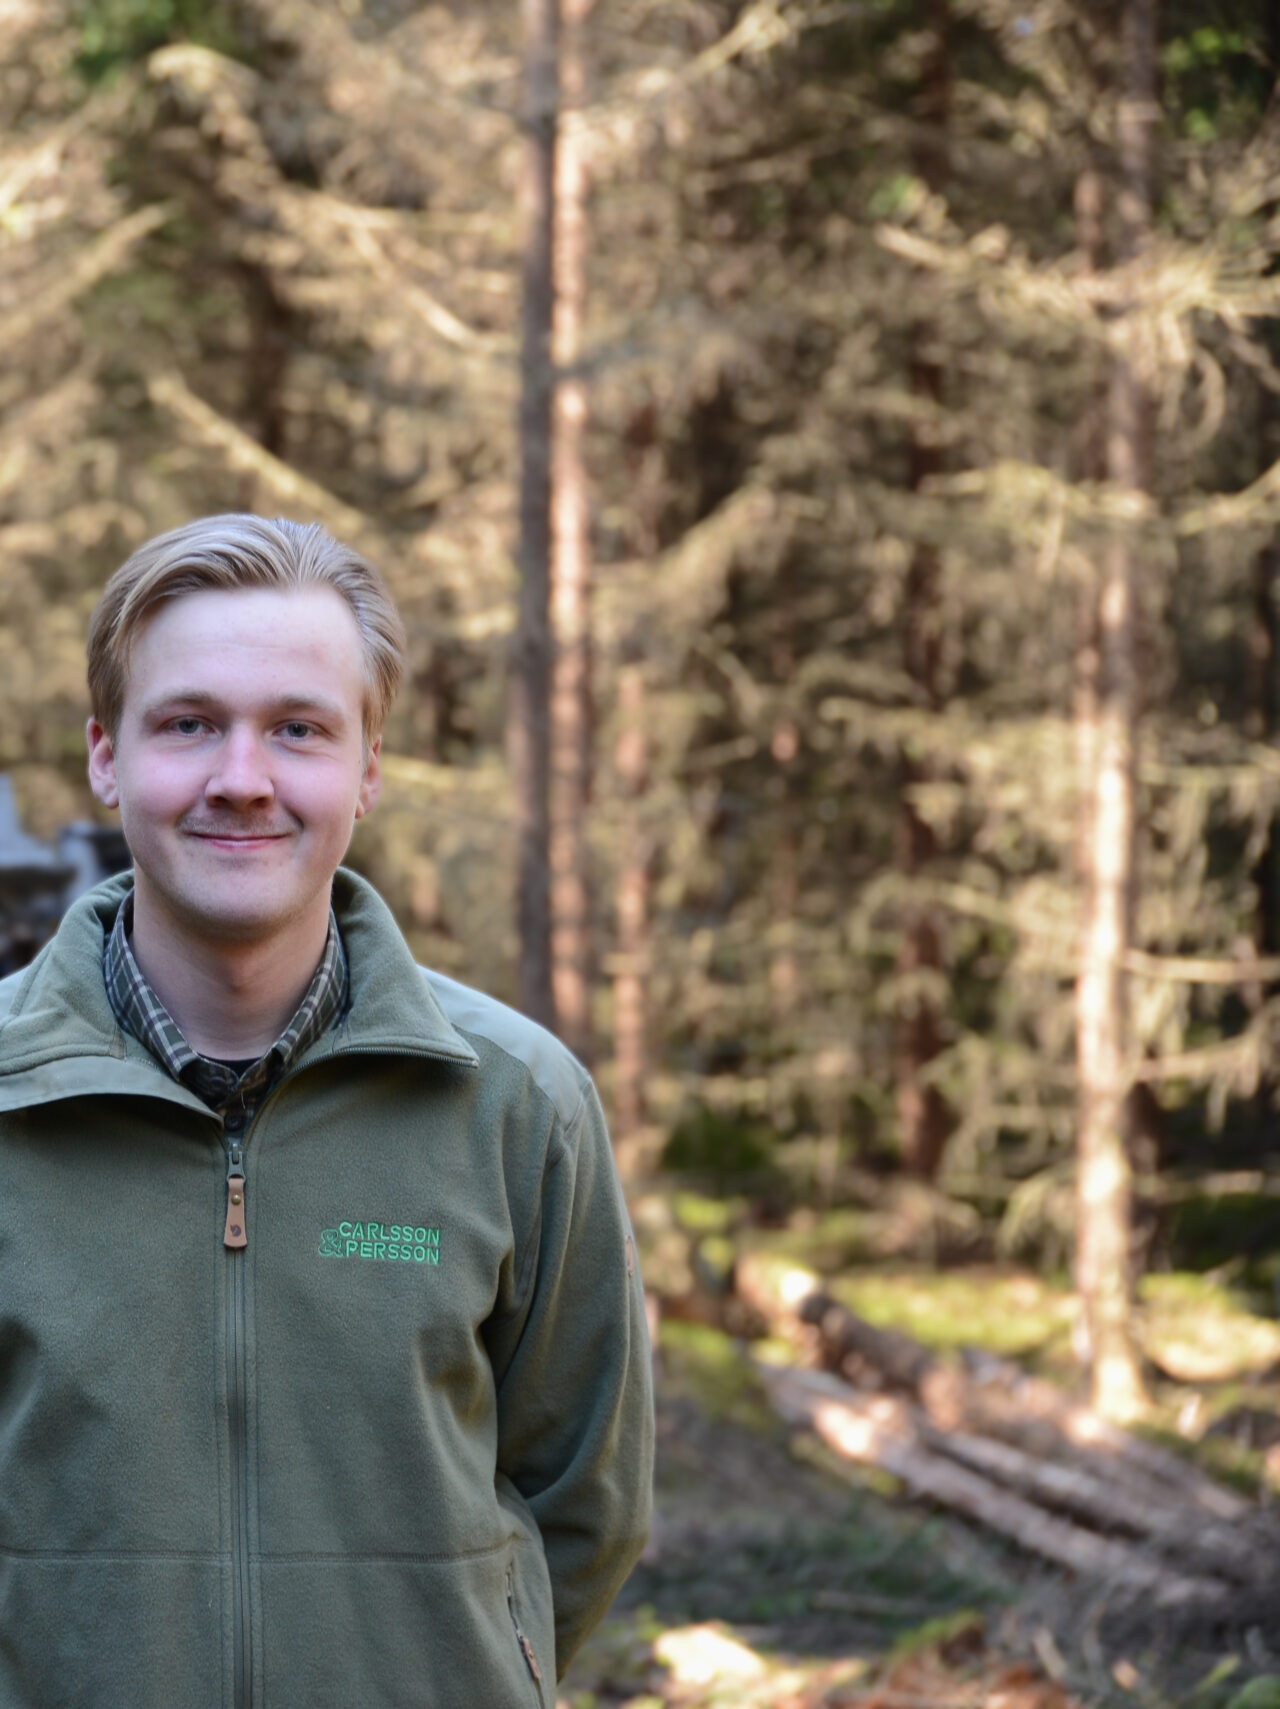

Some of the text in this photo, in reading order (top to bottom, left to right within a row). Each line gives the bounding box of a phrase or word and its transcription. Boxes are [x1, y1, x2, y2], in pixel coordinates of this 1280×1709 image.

[318, 1229, 439, 1265] & PERSSON
[339, 1221, 440, 1246] CARLSSON
